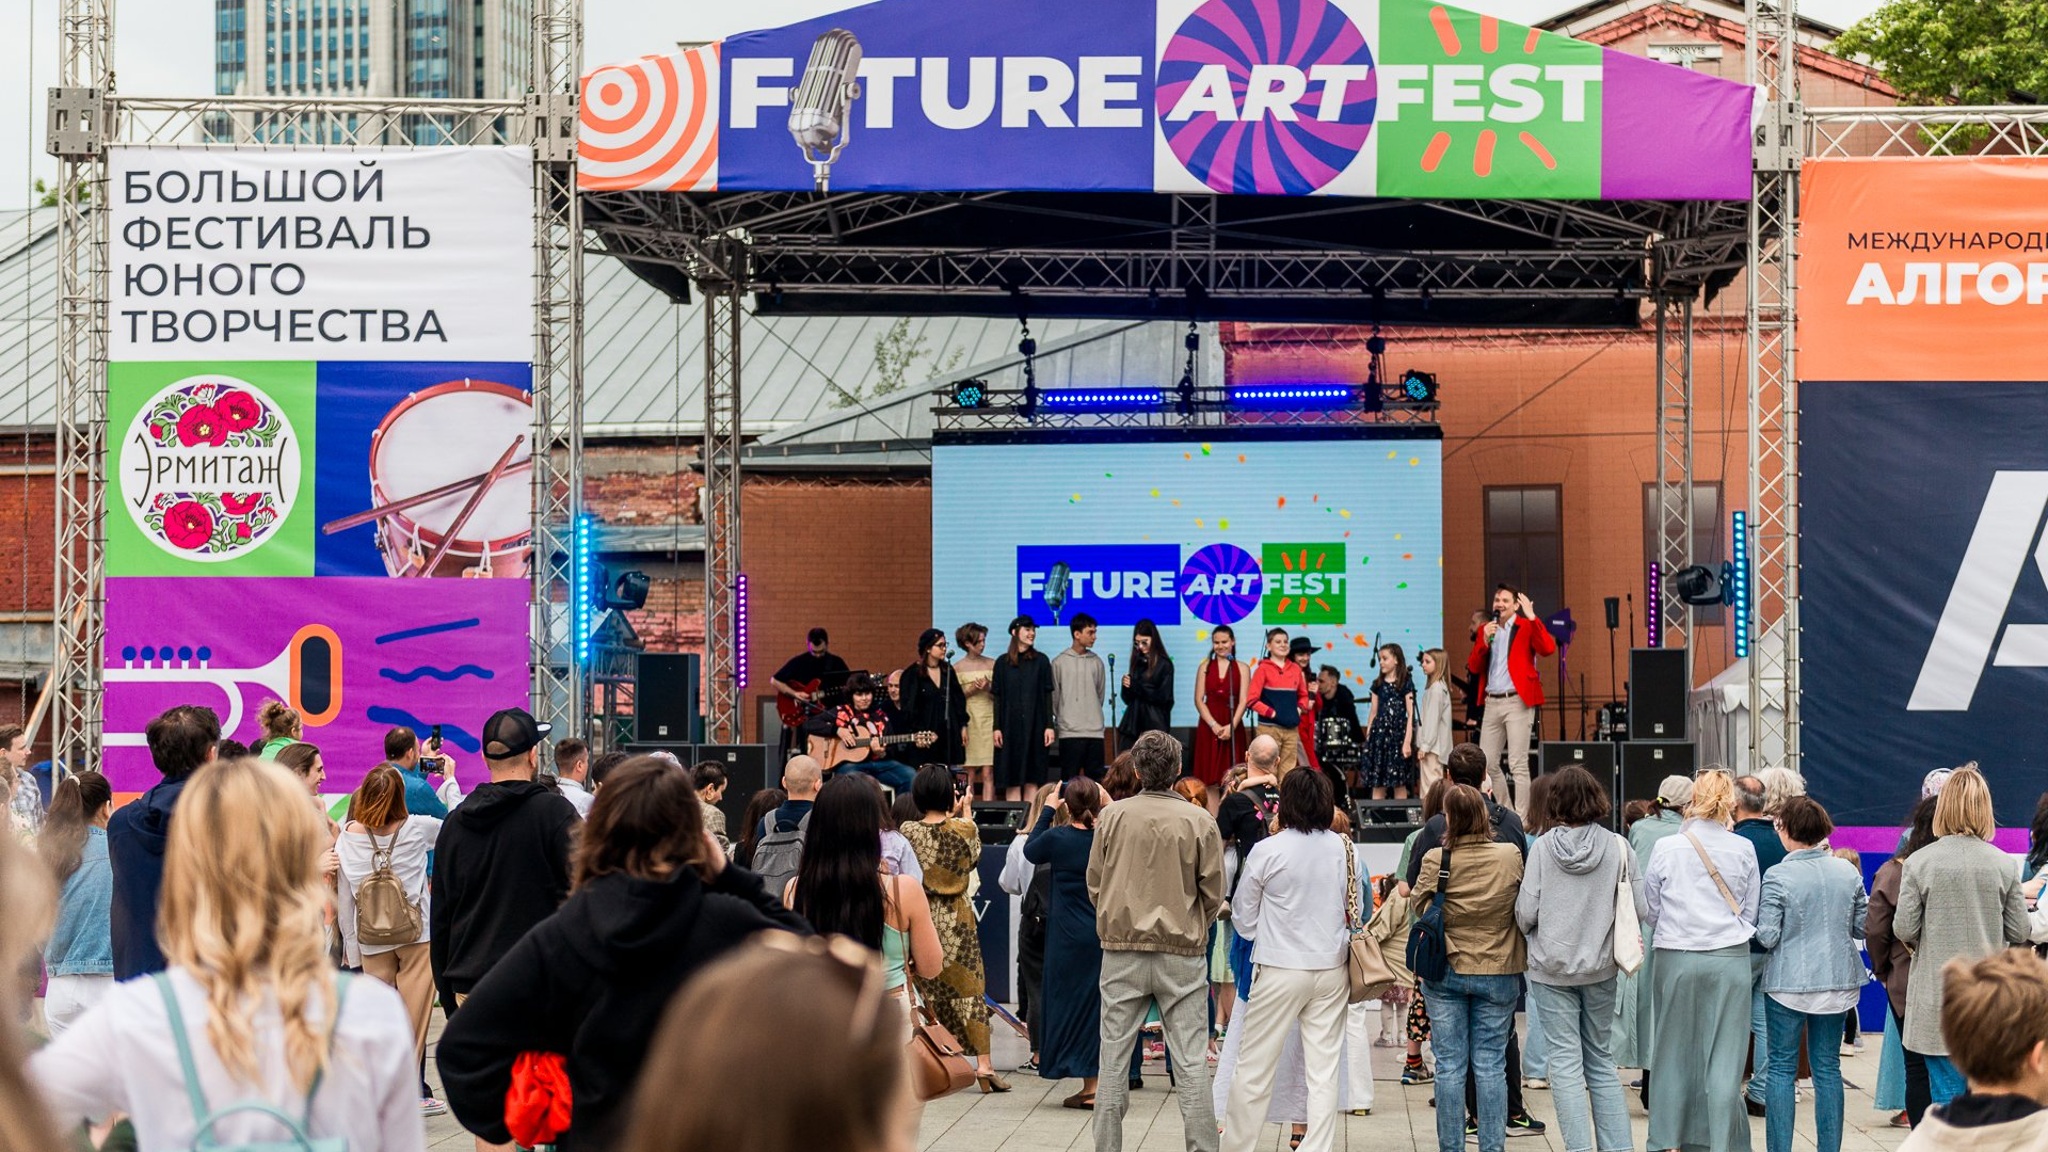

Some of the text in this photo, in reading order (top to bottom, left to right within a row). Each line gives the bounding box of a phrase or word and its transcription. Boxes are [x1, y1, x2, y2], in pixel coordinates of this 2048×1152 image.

[1164, 62, 1370, 123] ART
[1377, 62, 1604, 123] FEST
[124, 160, 384, 204] БОЛЬШОЙ
[122, 215, 431, 252] ФЕСТИВАЛЬ
[1847, 231, 2048, 253] МЕЖДУНАРОД
[124, 262, 306, 297] ЮНОГО
[121, 308, 448, 344] ТВОРЧЕСТВА
[1183, 572, 1261, 597] ART
[1262, 572, 1347, 596] FEST
